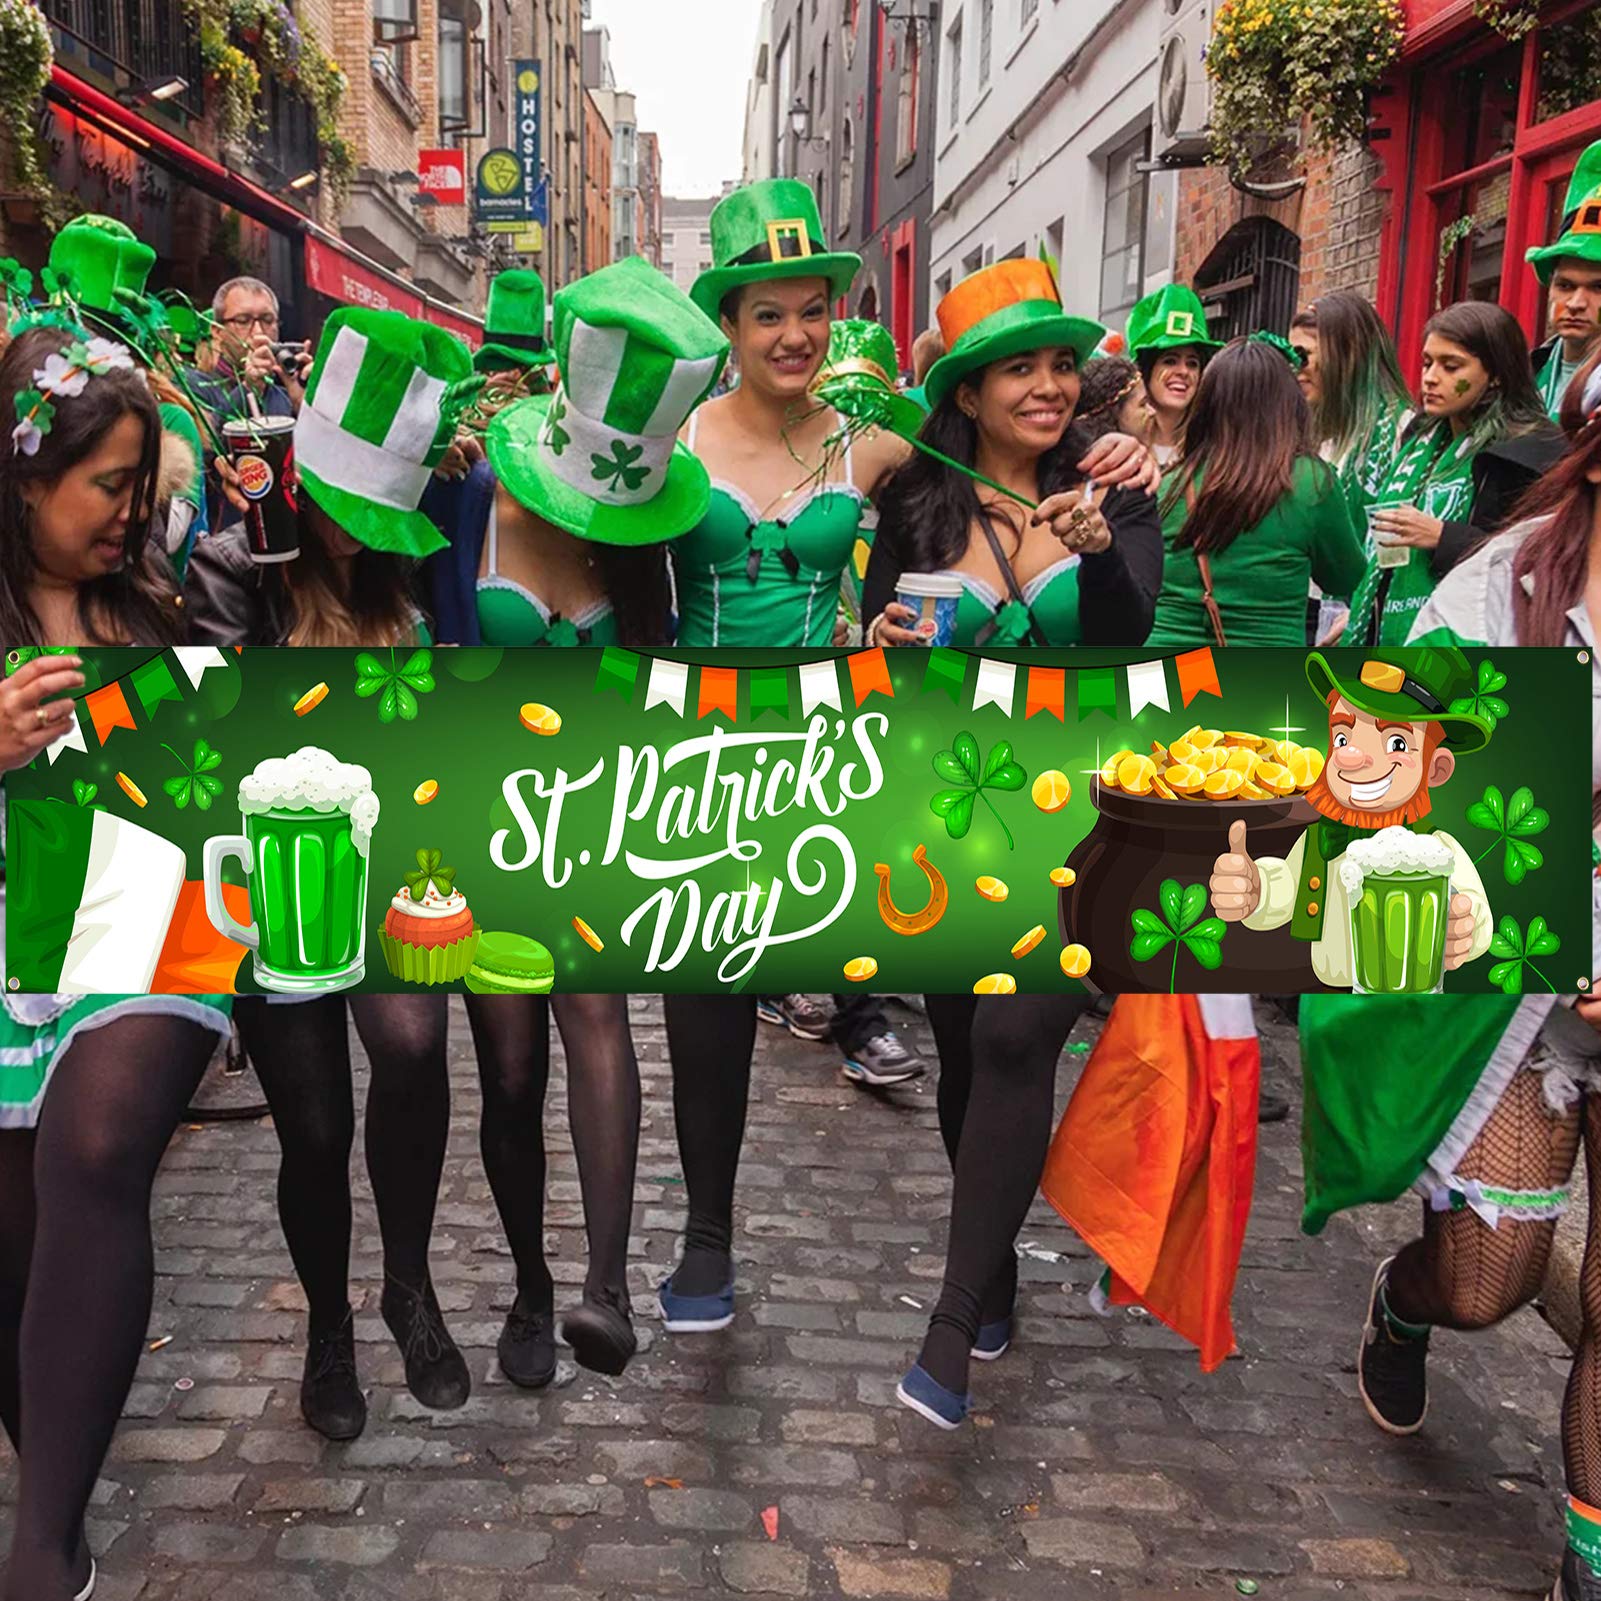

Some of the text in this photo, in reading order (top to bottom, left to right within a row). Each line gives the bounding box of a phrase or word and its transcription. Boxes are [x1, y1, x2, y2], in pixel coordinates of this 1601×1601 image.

[522, 99, 536, 211] HOSTEL
[489, 756, 605, 889] St.
[620, 823, 858, 983] Day
